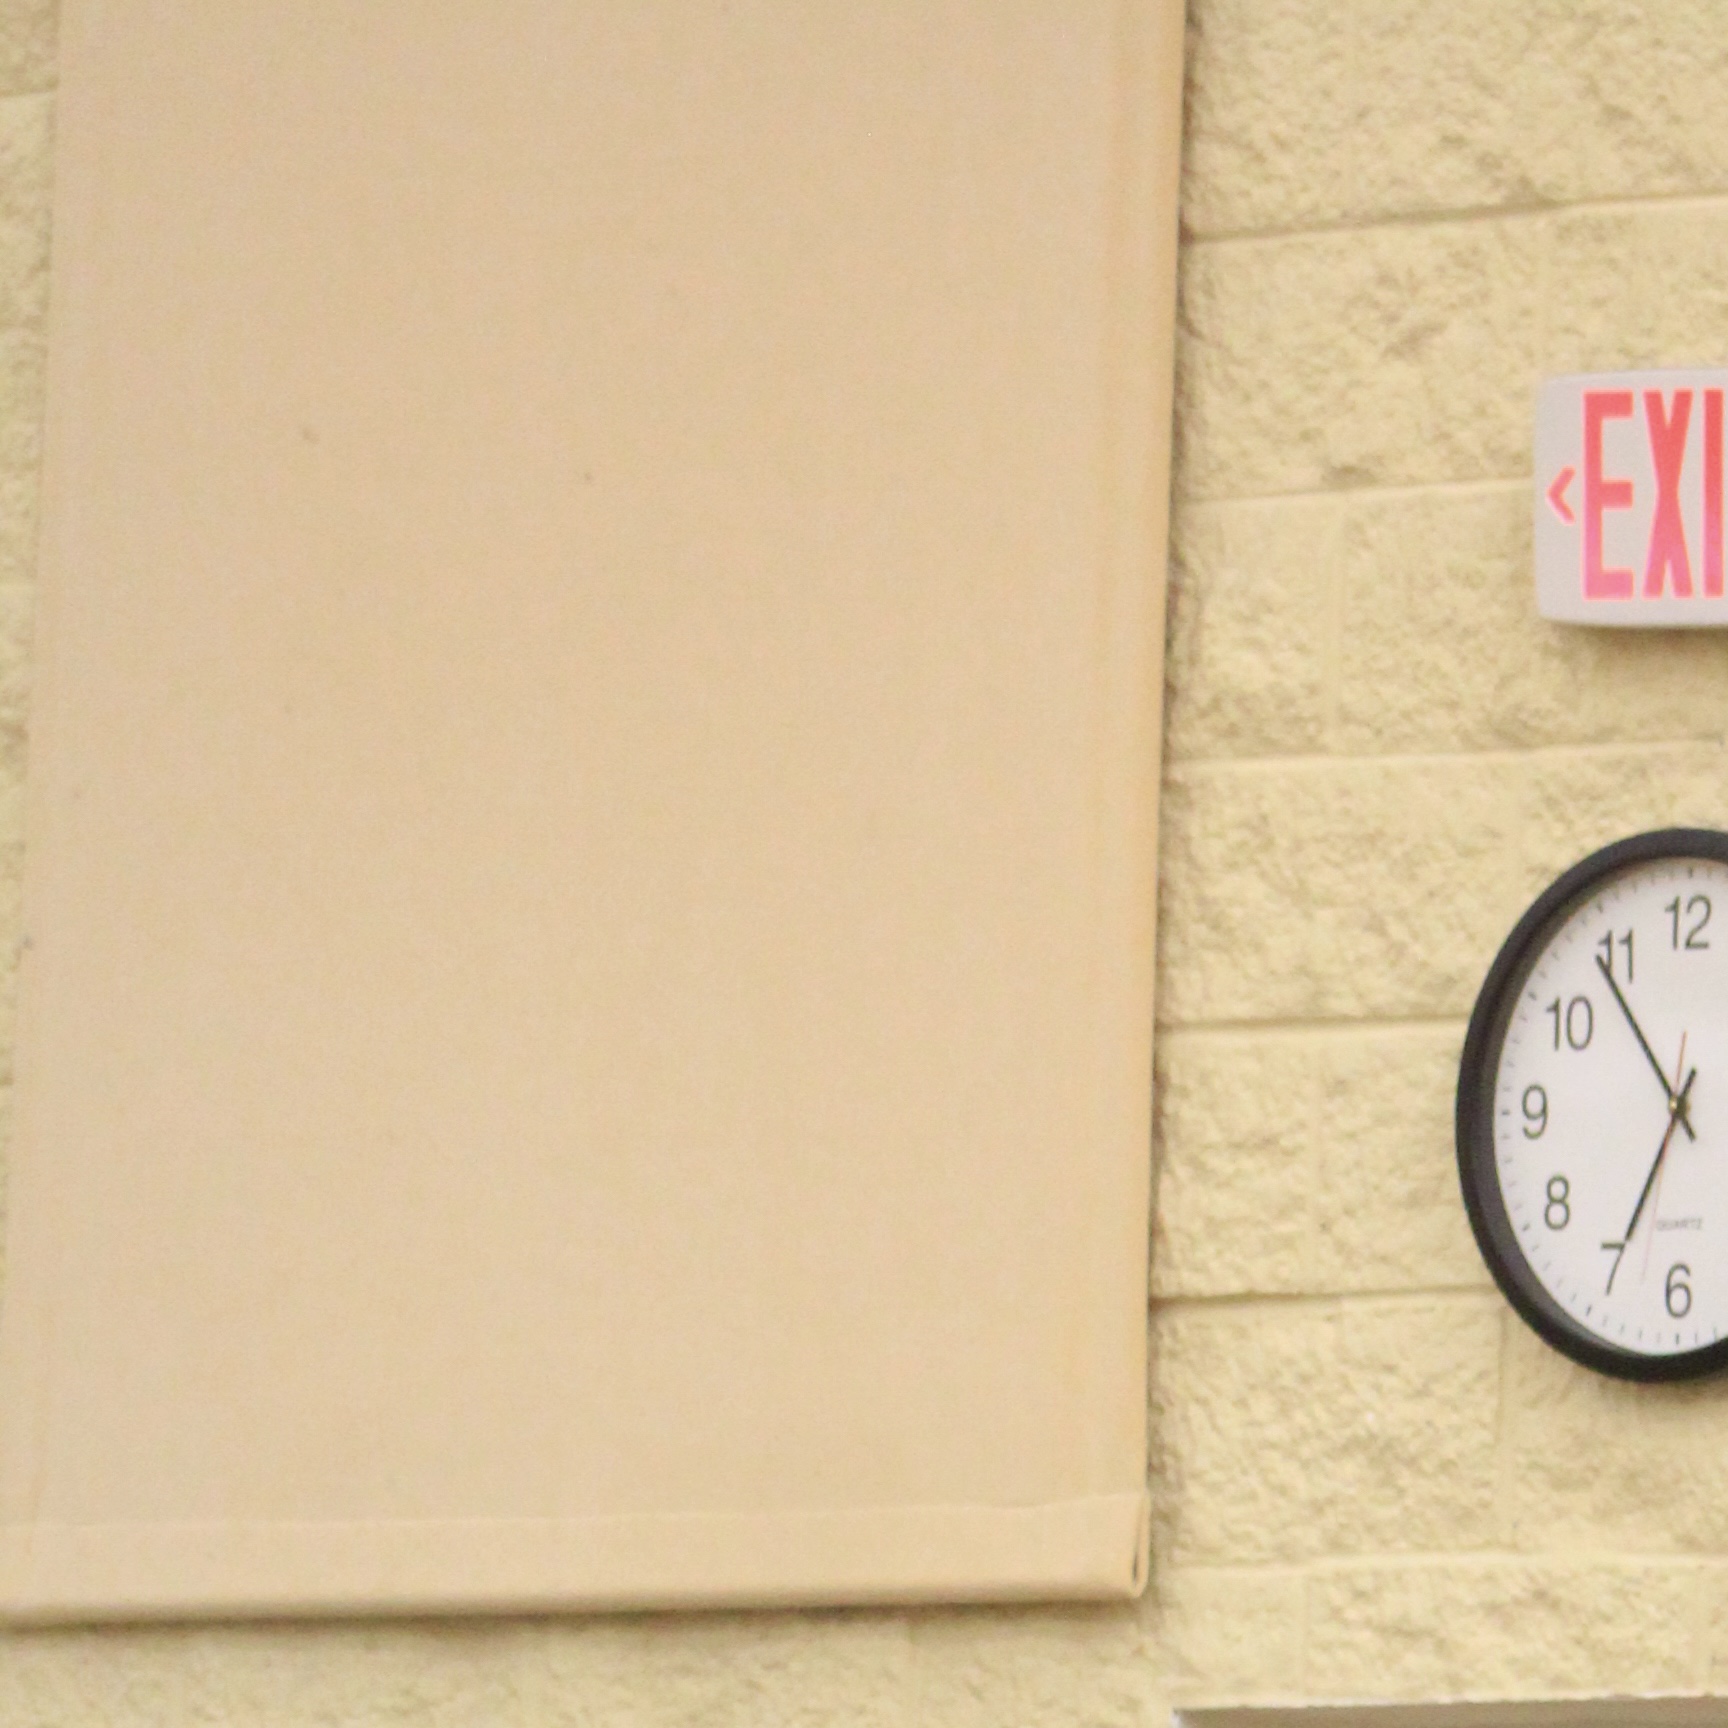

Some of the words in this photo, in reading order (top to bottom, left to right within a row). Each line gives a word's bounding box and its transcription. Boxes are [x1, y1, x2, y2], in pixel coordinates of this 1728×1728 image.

[1664, 893, 1713, 951] 12
[1598, 929, 1634, 984] 11
[1545, 995, 1594, 1051] 10
[1521, 1083, 1549, 1140] 9
[1543, 1174, 1571, 1232] 8
[1601, 1240, 1627, 1296] 7
[1664, 1262, 1692, 1319] 6
